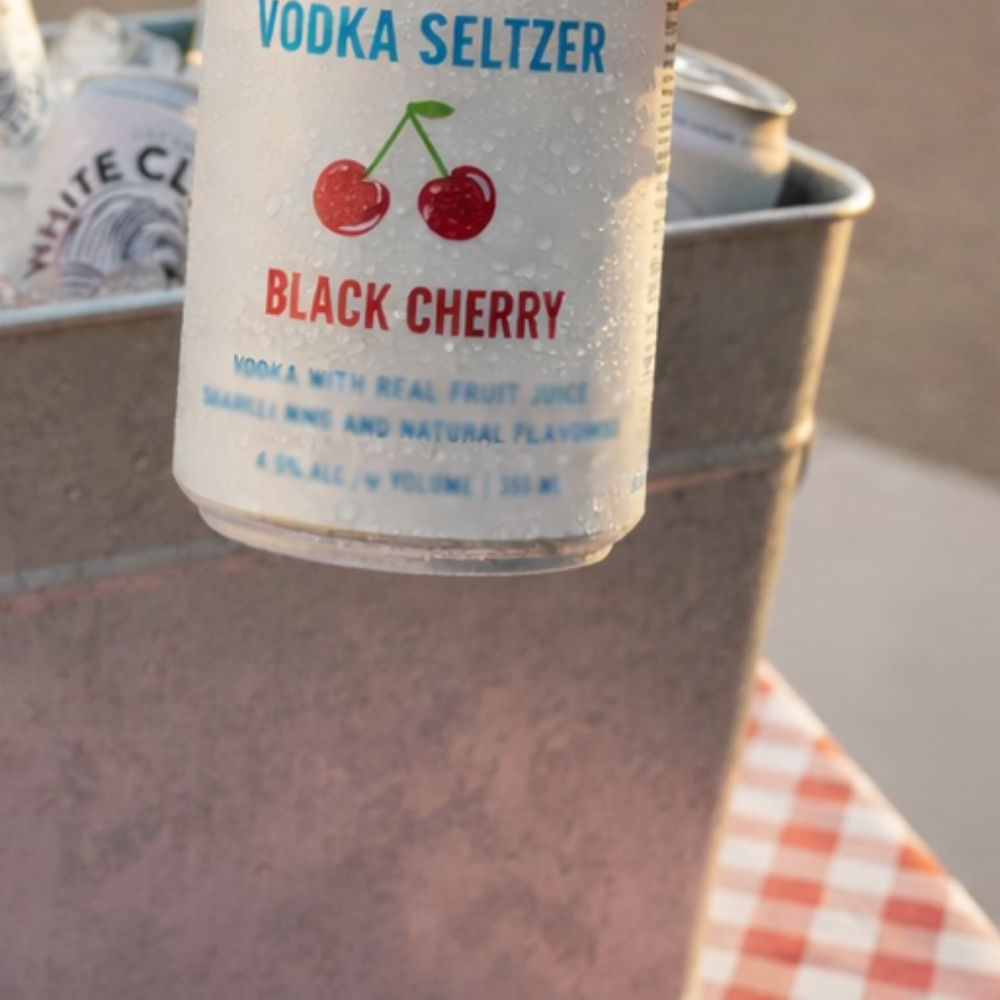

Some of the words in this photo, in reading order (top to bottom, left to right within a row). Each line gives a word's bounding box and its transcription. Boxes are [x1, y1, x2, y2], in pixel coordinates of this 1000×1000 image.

[418, 11, 608, 74] SELTZER
[136, 145, 189, 197] CL
[264, 267, 392, 331] BLACK
[405, 286, 566, 340] CHERRY
[308, 367, 365, 394] WITH
[376, 374, 437, 404] REAL
[449, 378, 519, 404] FRUIT
[530, 380, 589, 406] JUICE
[343, 413, 390, 439] AND
[400, 418, 505, 445] NATURAL
